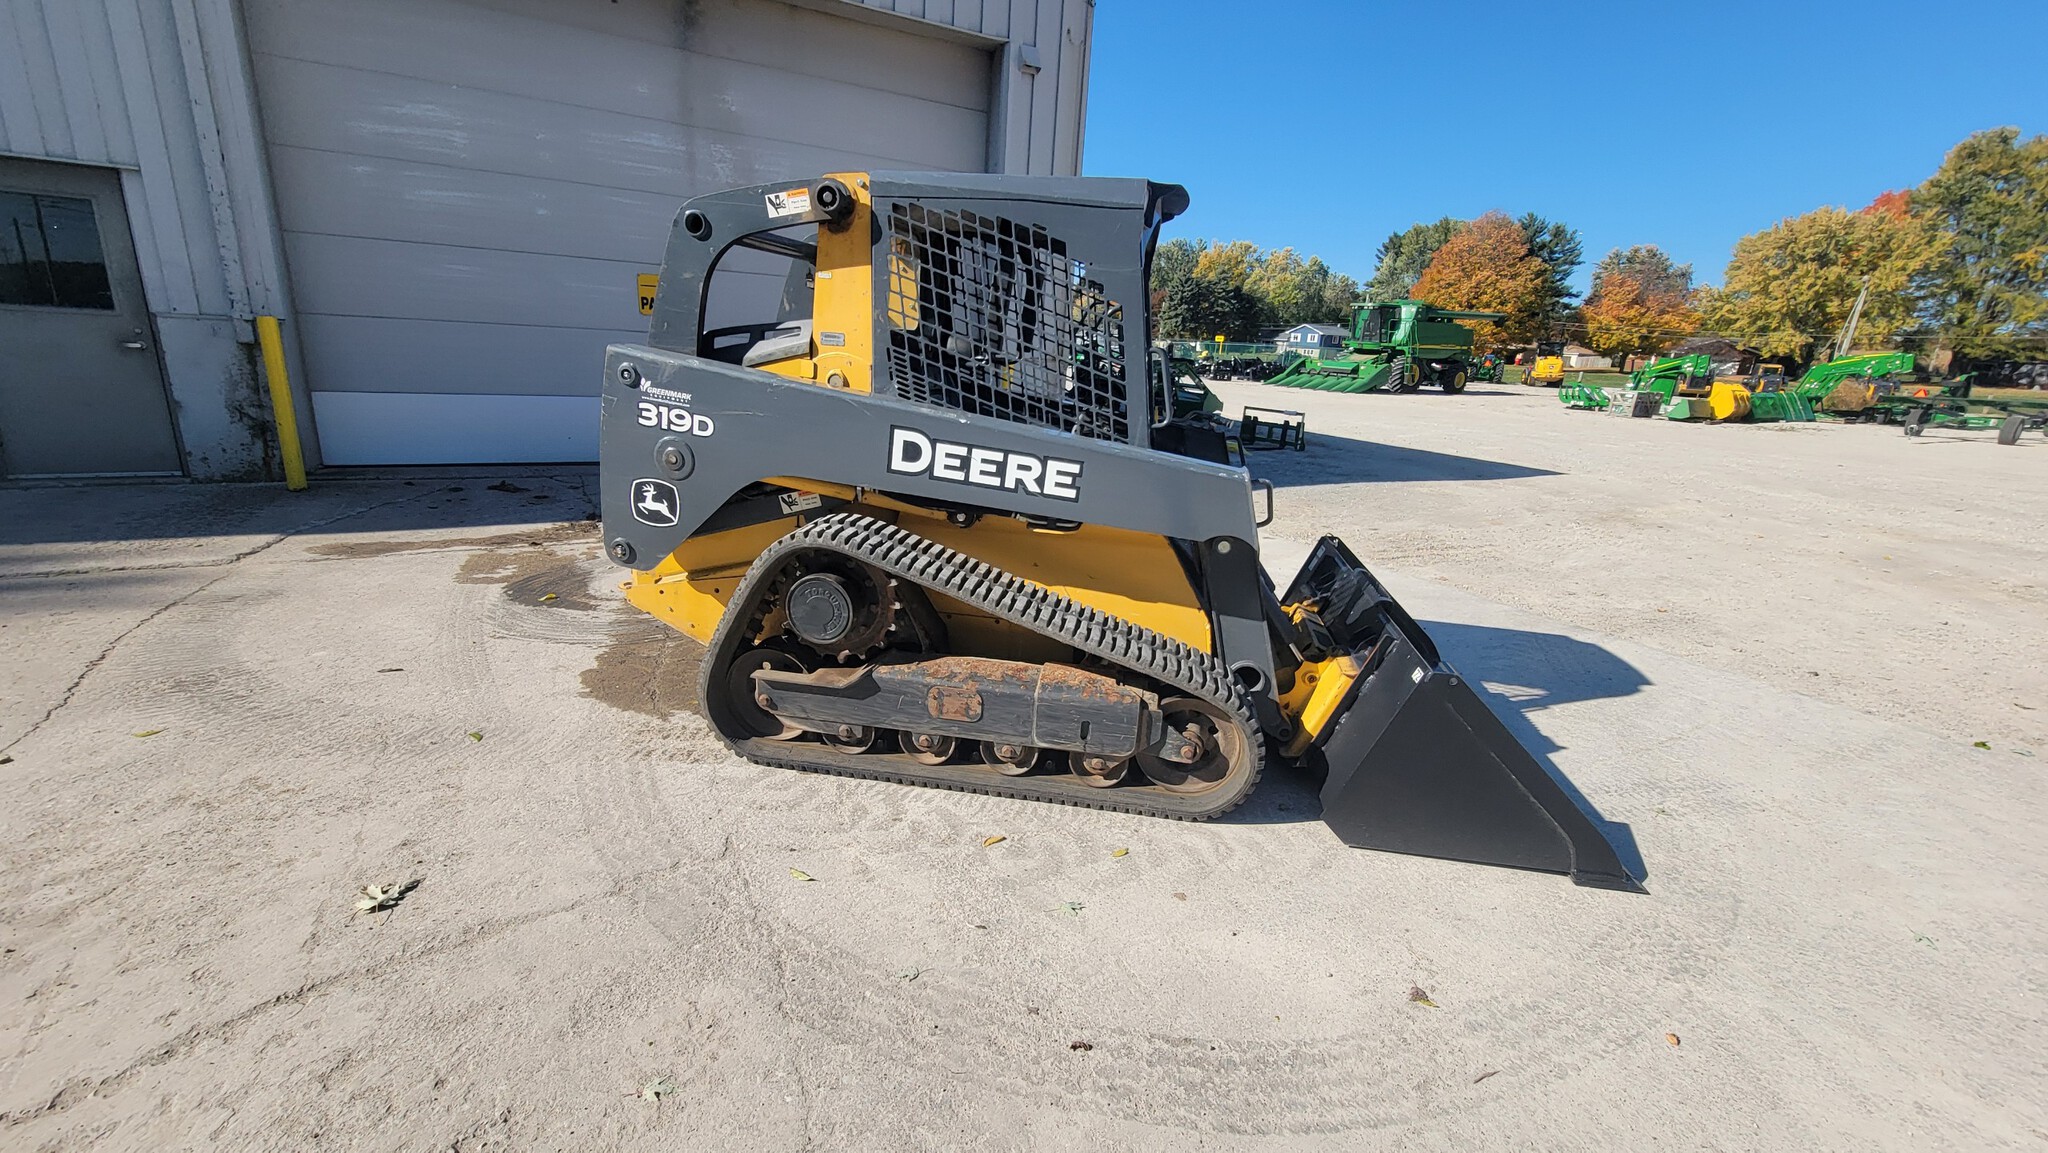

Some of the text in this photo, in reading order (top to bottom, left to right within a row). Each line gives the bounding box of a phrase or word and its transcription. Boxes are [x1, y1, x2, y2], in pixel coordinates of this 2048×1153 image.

[647, 386, 692, 401] GREENMARK
[638, 402, 714, 437] 319D
[890, 428, 1082, 499] DEERE
